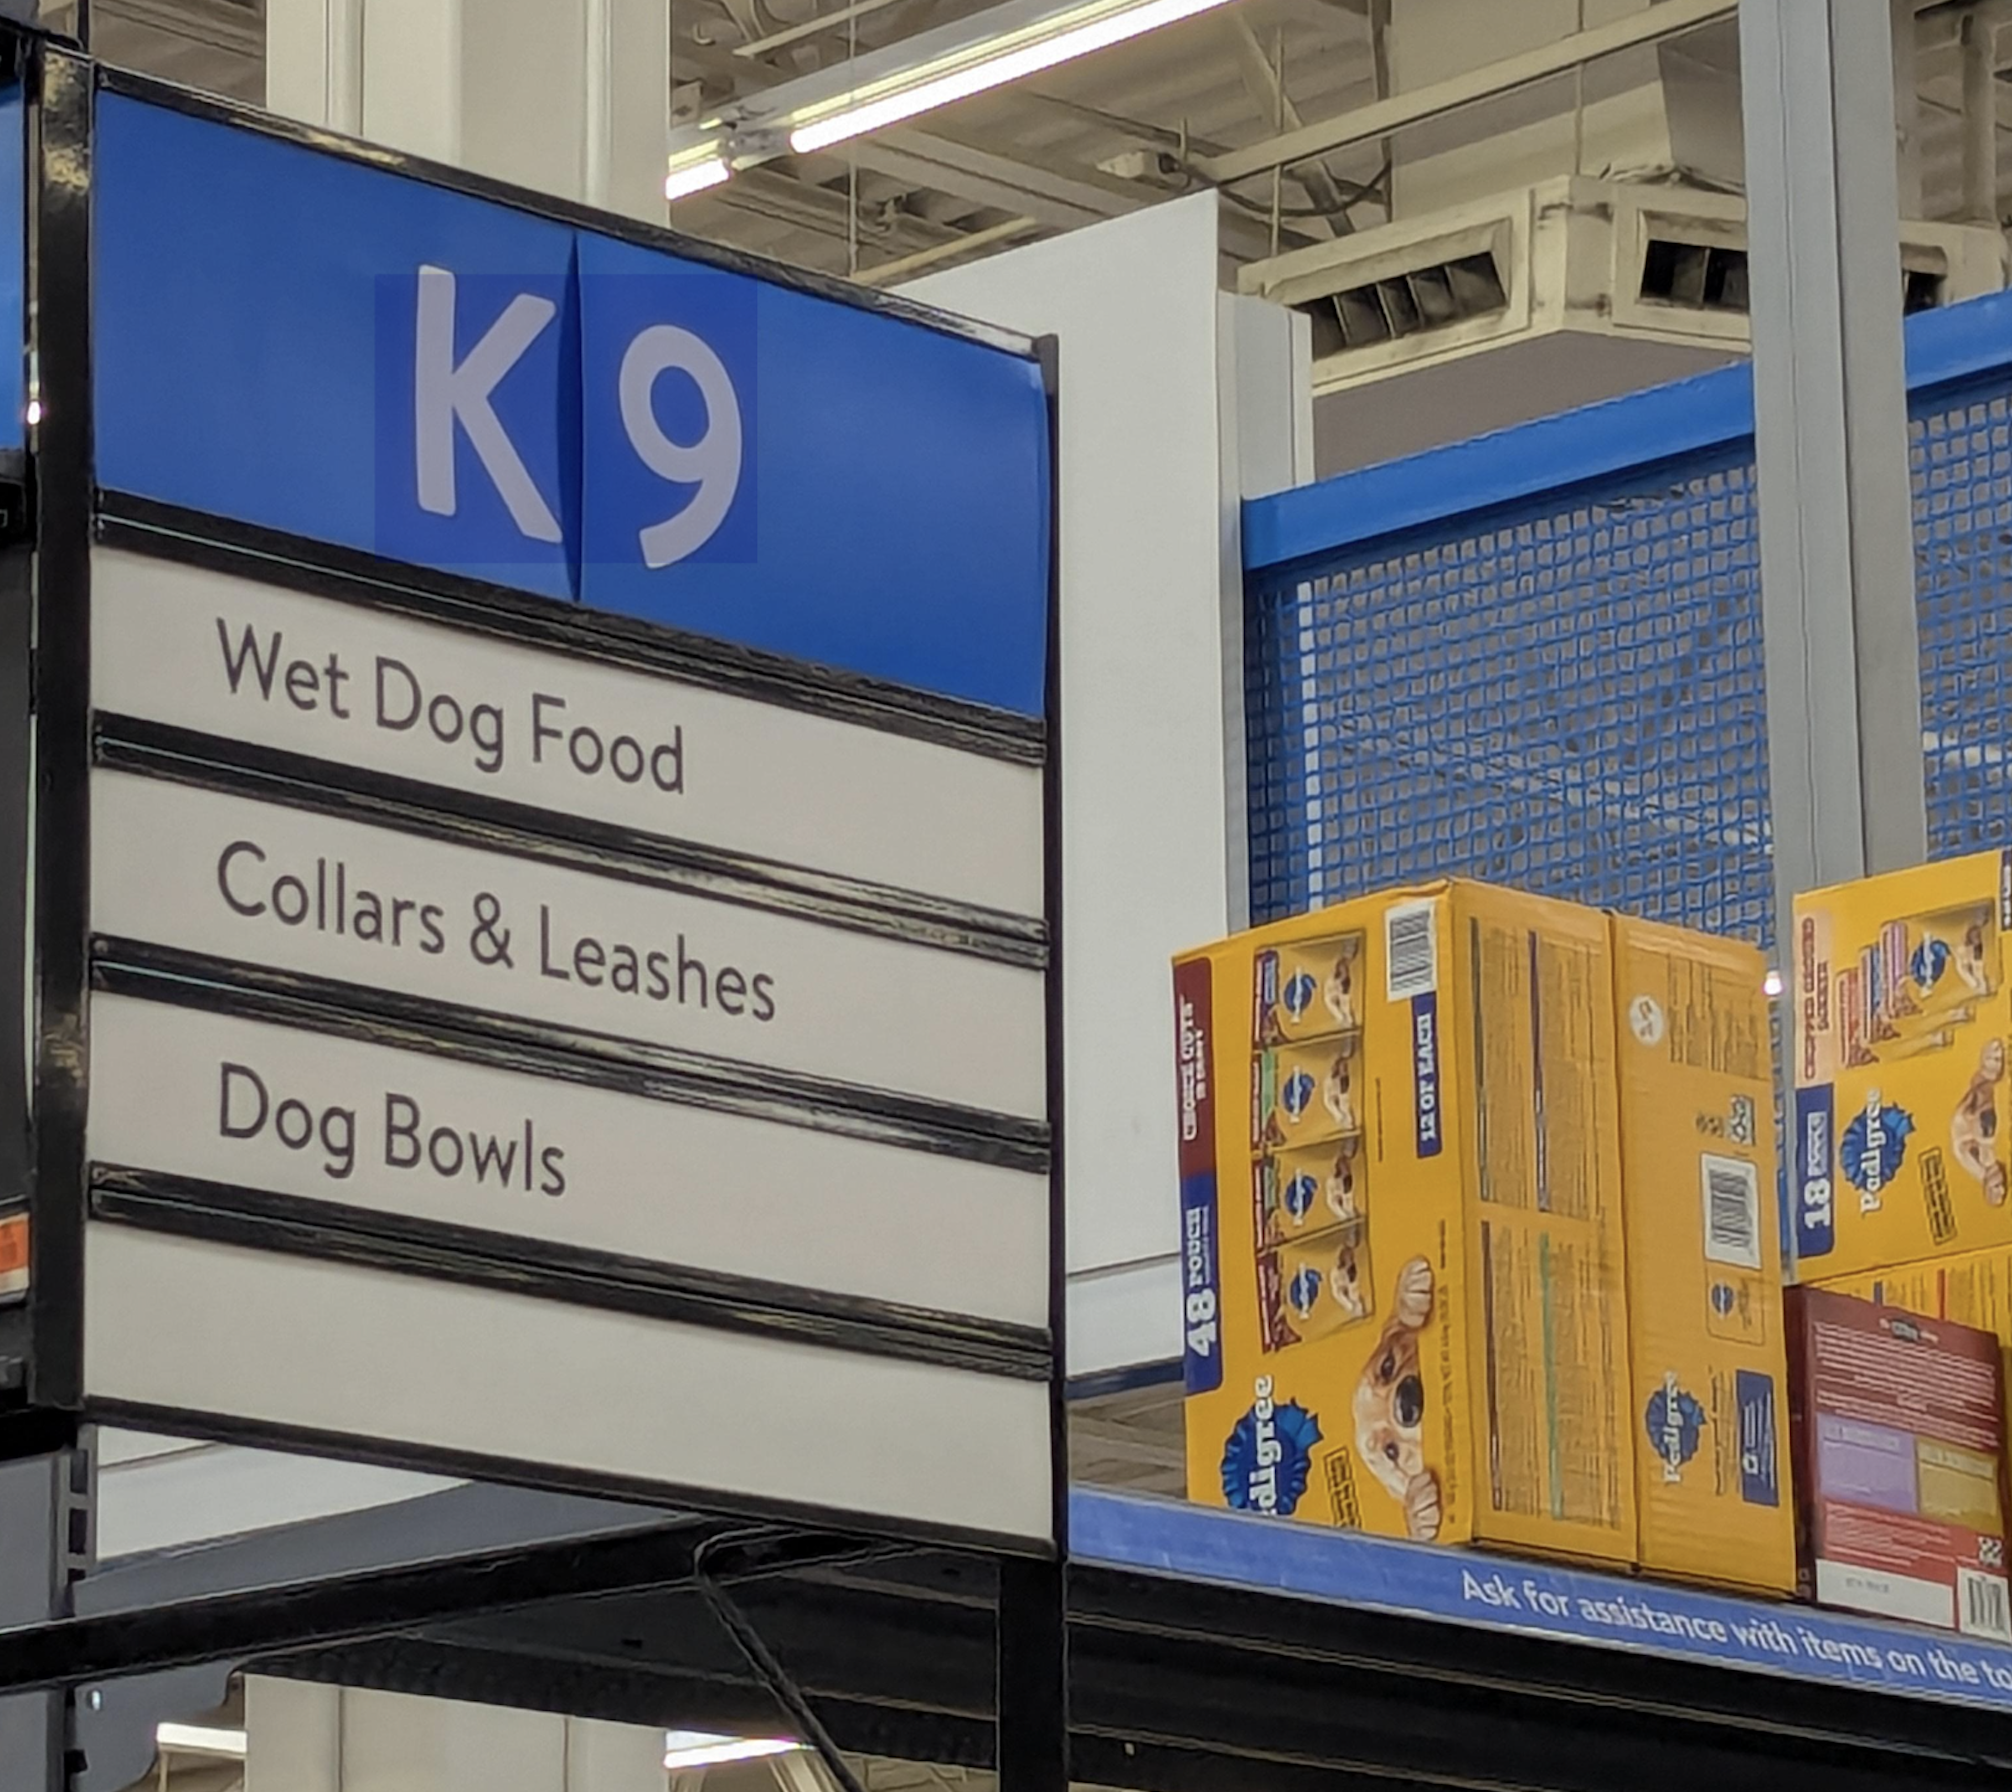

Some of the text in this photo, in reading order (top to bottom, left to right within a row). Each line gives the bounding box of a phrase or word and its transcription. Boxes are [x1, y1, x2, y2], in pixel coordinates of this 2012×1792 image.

[215, 617, 684, 795] Wet Dog Food
[217, 840, 775, 1022] Collars & Leashes
[219, 1061, 566, 1197] Dog Bowls
[1804, 1178, 1831, 1229] 18
[1186, 1287, 1217, 1357] 48
[1249, 1374, 1282, 1516] digree
[1461, 1568, 1521, 1610] Ask
[1522, 1579, 1569, 1617] for
[1576, 1595, 1729, 1643] assistance
[1731, 1618, 1798, 1656] with
[1797, 1626, 1883, 1669] items
[1886, 1649, 1927, 1677] on
[1928, 1649, 1980, 1685] the
